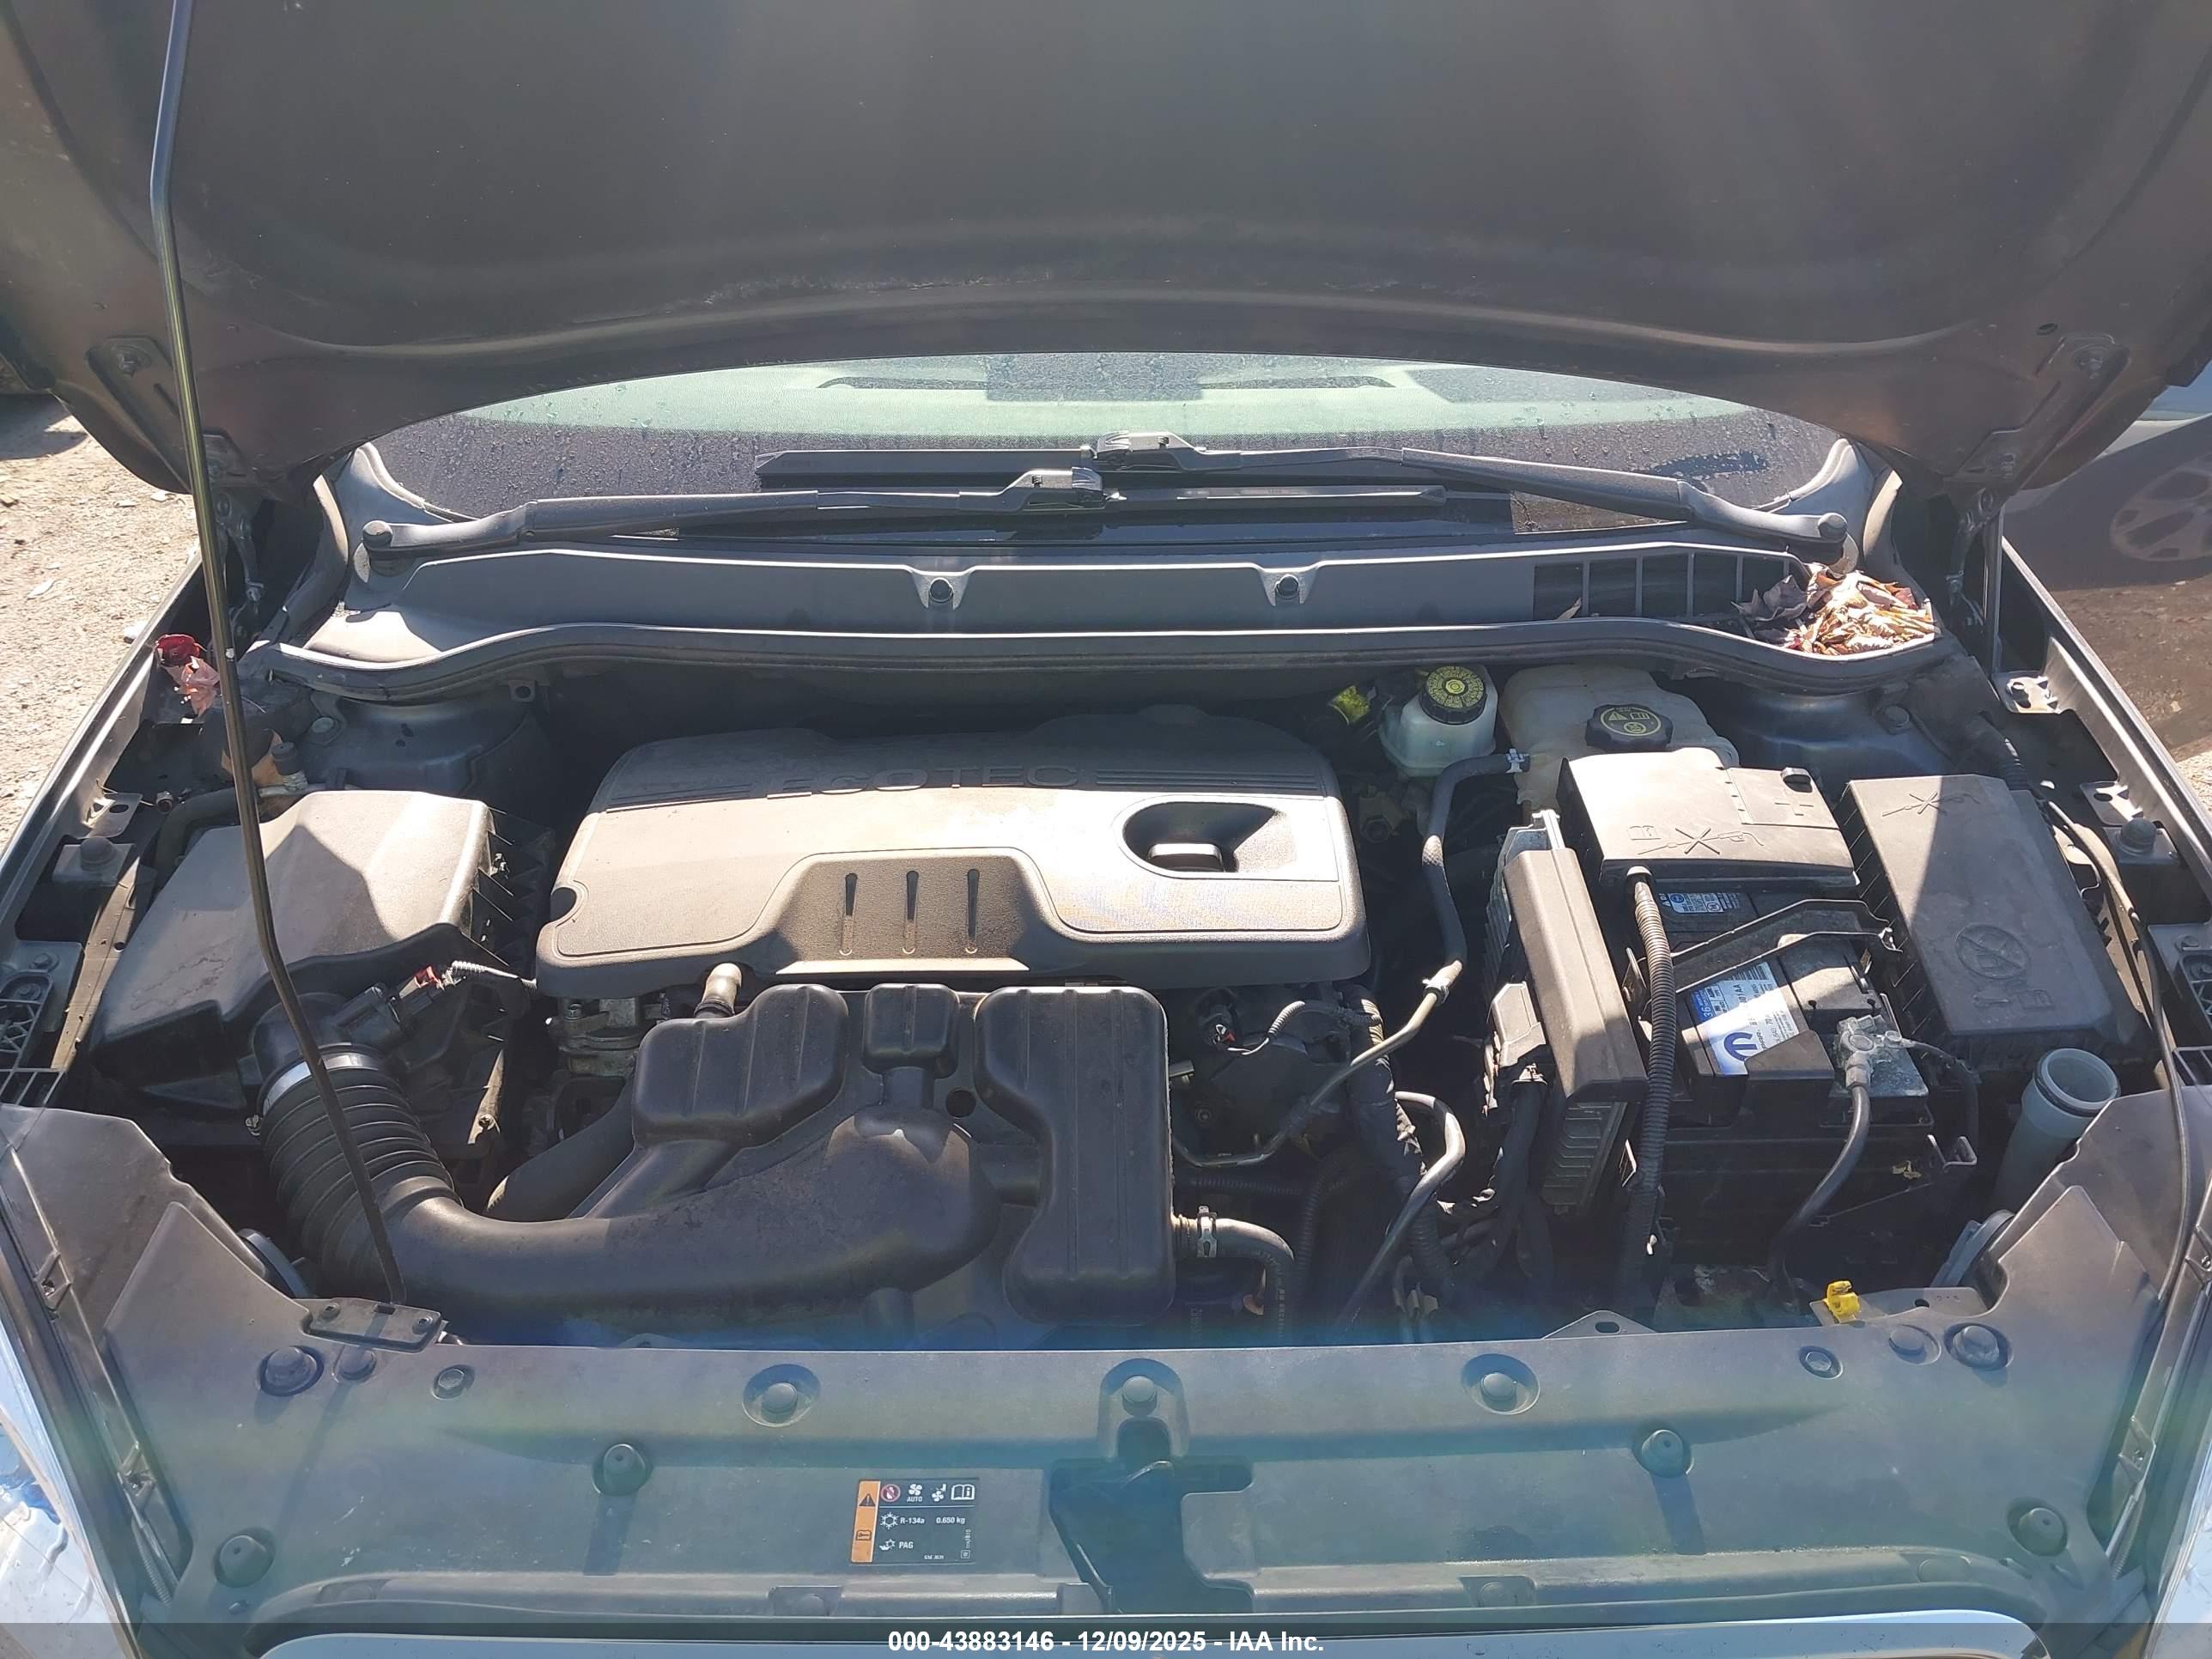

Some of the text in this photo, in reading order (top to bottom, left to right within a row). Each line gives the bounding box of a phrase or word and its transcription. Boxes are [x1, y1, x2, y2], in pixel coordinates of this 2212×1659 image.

[766, 765, 1079, 799] ECOTEC
[1702, 1006, 1714, 1018] 36
[956, 1516, 965, 1525] kg
[898, 1540, 914, 1549] PAG
